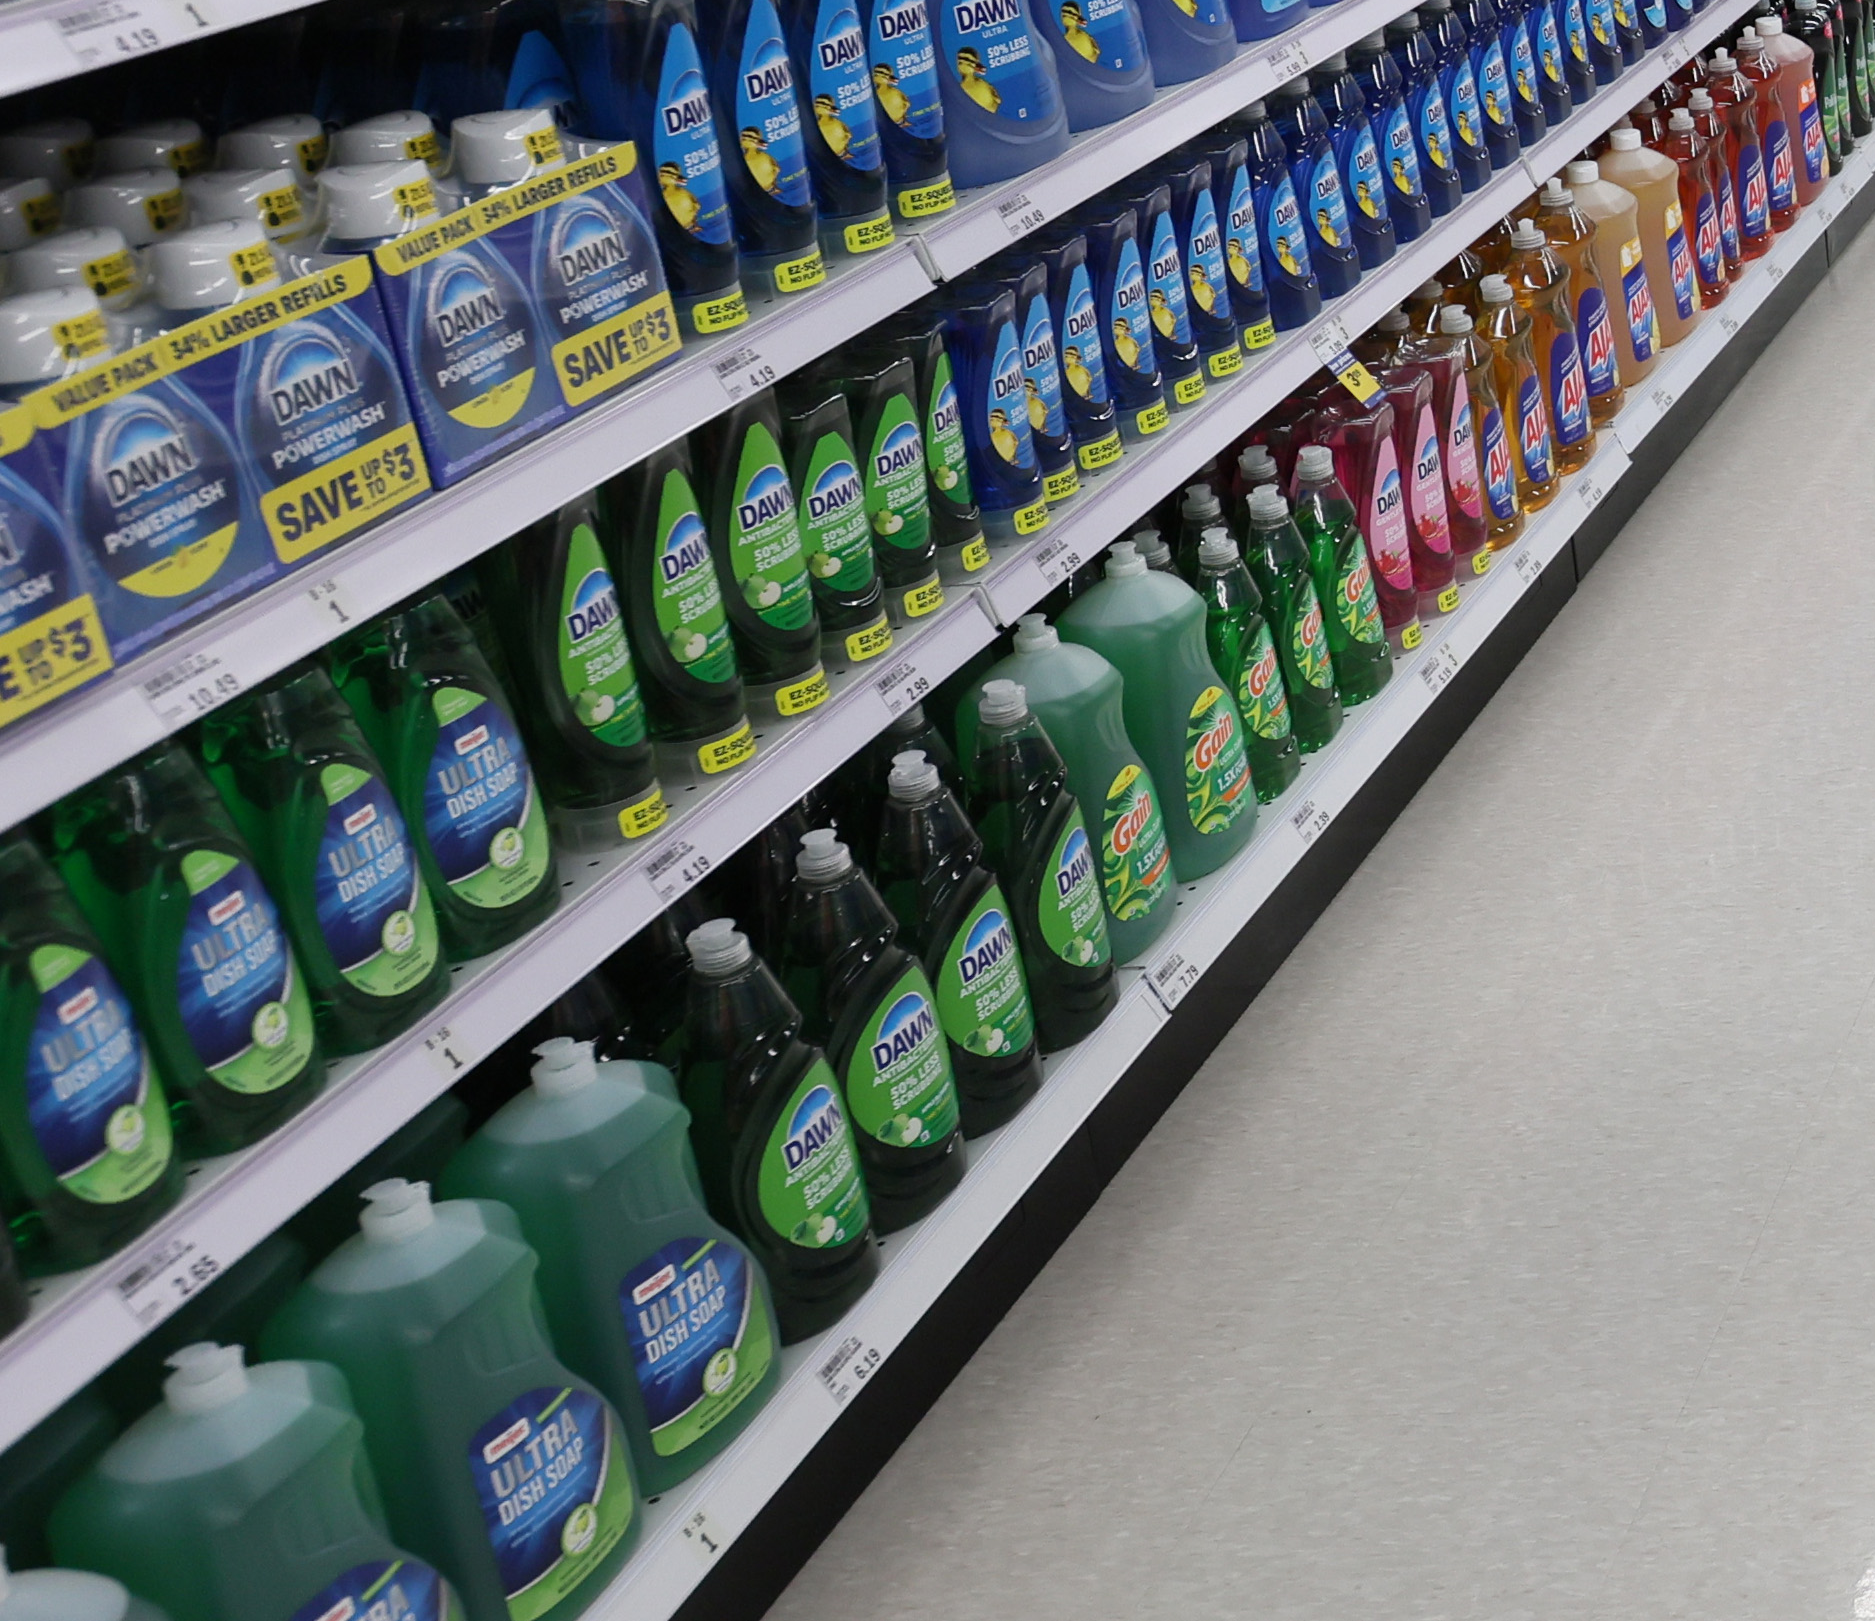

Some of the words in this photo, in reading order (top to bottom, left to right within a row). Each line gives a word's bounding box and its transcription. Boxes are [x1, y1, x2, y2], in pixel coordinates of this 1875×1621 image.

[112, 29, 159, 54] 4.19
[982, 24, 1008, 38] ULTRA
[987, 41, 1010, 57] 50%
[1011, 36, 1029, 52] LESS
[989, 46, 1032, 68] SCRUBBING
[1021, 209, 1045, 231] 10.49
[53, 374, 109, 412] VALUE
[112, 351, 157, 388] PACK
[169, 328, 210, 359] 34%
[213, 302, 278, 341] LARGER
[282, 275, 347, 313] REFILLS
[271, 361, 358, 424] DAWN
[749, 365, 775, 387] 4.19
[272, 404, 385, 470] POWERWASH
[107, 435, 197, 506] DAWN
[359, 458, 381, 480] UP
[384, 443, 416, 481] $3
[366, 477, 386, 498] TO
[276, 470, 364, 541] SAVE
[1059, 553, 1082, 576] 2.99
[188, 672, 242, 710] 10.49
[905, 677, 930, 702] 2.99
[1113, 790, 1154, 856] Gain
[959, 921, 1013, 983] DAWN
[872, 1003, 934, 1073] DAWN
[638, 1259, 721, 1339] ULTRA
[646, 1323, 689, 1365] DISH
[688, 1285, 726, 1332] SOAP
[853, 1347, 883, 1380] 6.19
[700, 1534, 719, 1554] 1
